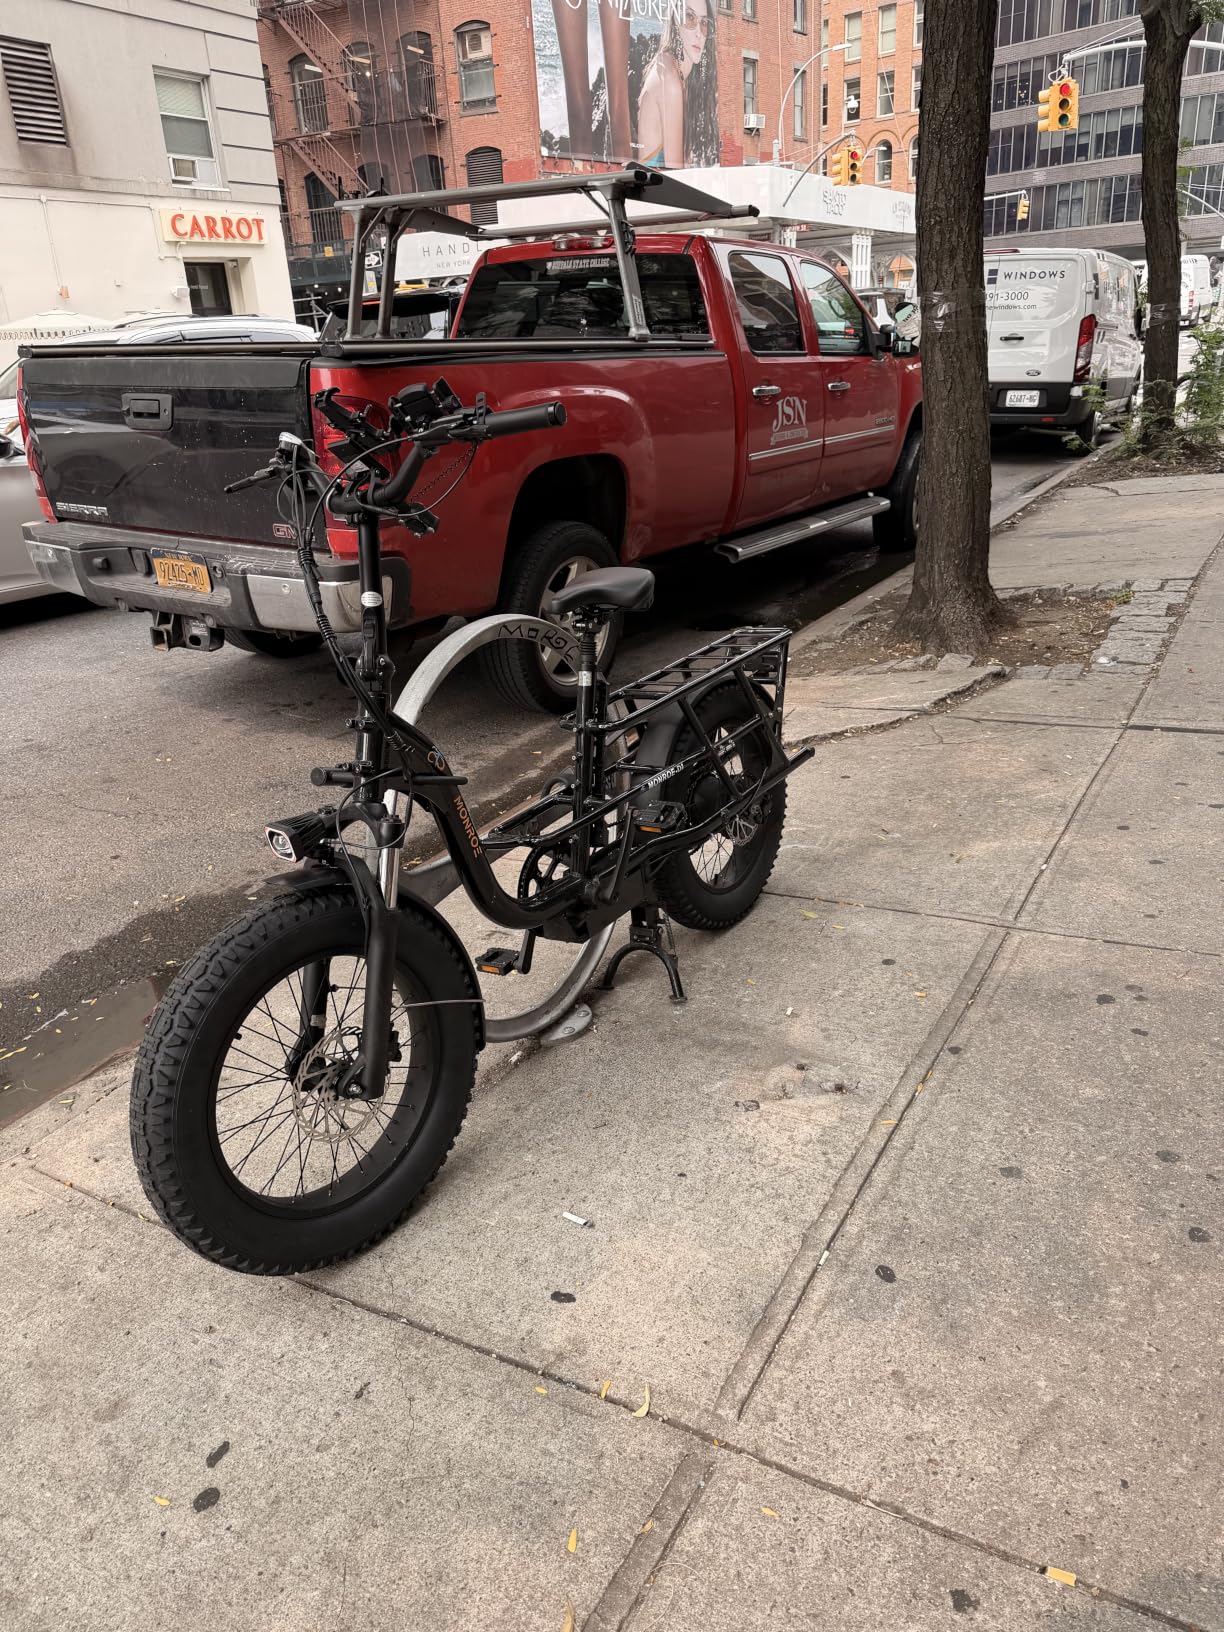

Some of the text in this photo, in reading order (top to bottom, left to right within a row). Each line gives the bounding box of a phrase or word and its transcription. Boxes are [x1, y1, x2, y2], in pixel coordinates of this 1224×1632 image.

[170, 213, 264, 241] CARROT
[423, 242, 483, 257] HANDL
[1003, 270, 1066, 280] WINDOWS
[772, 397, 807, 432] JSN
[56, 502, 108, 516] SIERRA
[453, 795, 482, 857] MONROE
